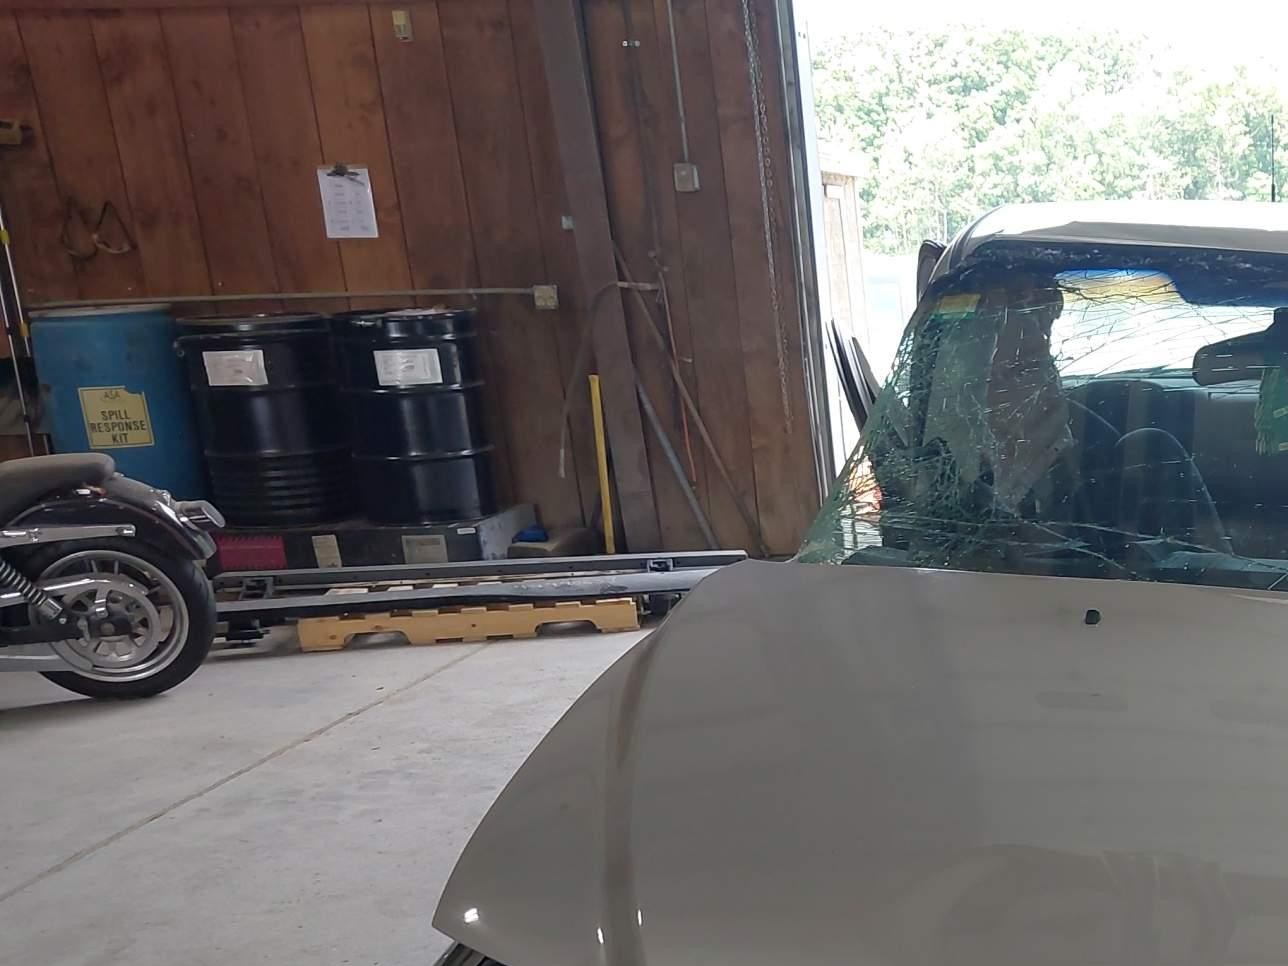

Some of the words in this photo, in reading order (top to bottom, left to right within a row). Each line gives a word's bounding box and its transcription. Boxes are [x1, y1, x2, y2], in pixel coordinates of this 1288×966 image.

[100, 409, 130, 421] SPILL
[90, 420, 147, 433] RESPONSE
[112, 432, 129, 444] KIT
